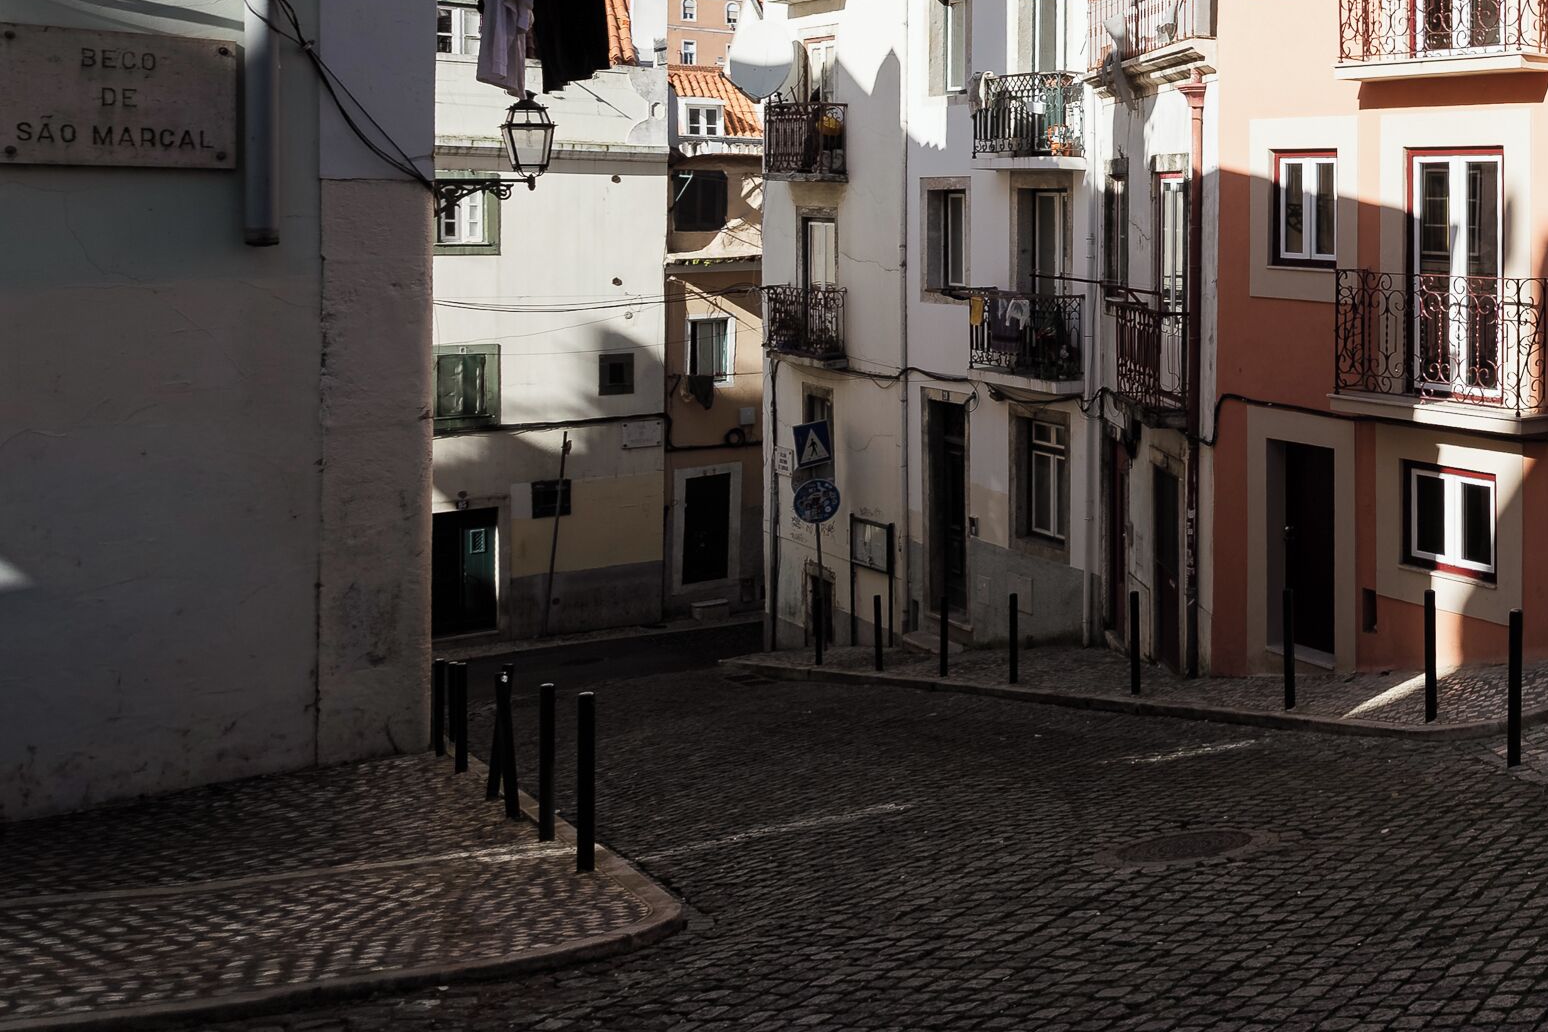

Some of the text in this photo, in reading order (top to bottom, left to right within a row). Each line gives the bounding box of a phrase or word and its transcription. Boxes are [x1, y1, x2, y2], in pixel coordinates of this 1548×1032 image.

[79, 47, 157, 72] BECO
[101, 87, 138, 109] DE
[15, 114, 78, 144] SÃO
